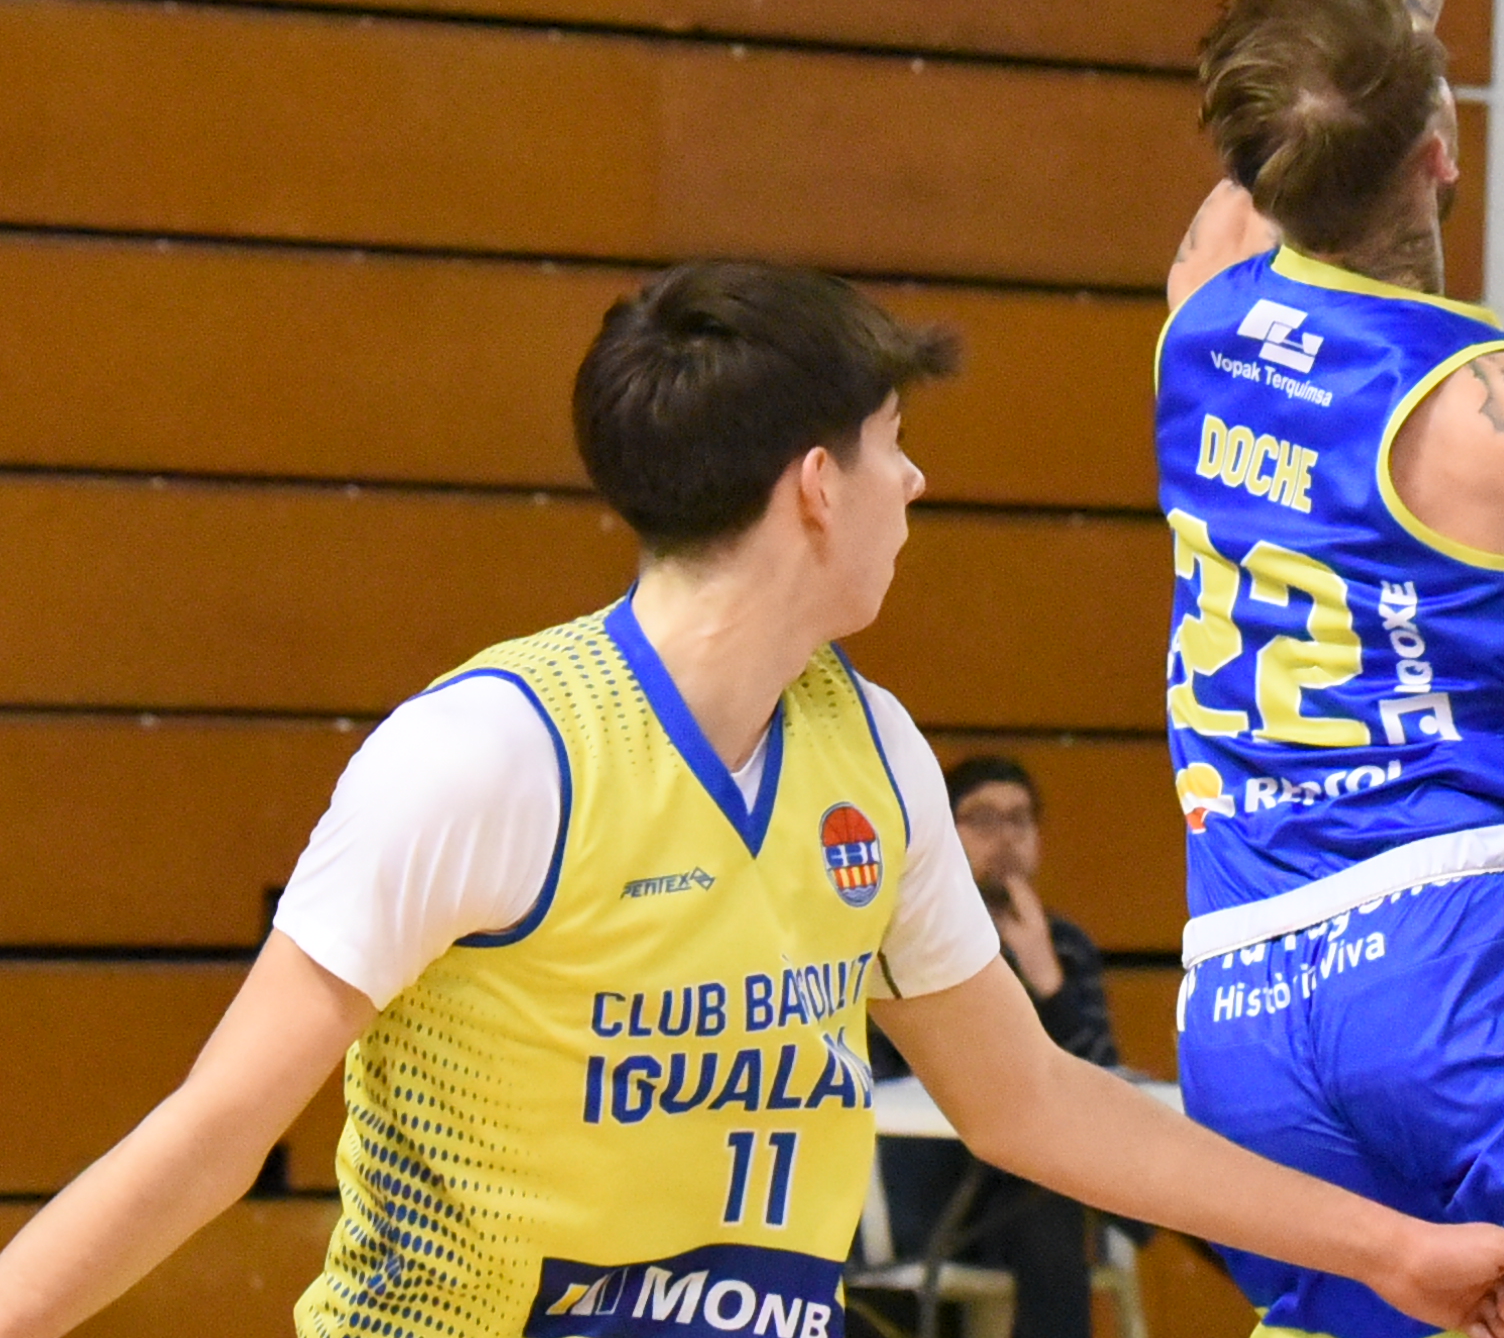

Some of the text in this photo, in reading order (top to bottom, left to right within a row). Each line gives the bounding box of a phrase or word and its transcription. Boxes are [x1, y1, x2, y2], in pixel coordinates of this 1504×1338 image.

[1210, 350, 1262, 383] Vopak
[1195, 412, 1319, 515] DOCHE
[1167, 507, 1371, 747] 22
[1378, 580, 1434, 693] IQOXE
[590, 981, 727, 1038] CLUB
[722, 1130, 798, 1227] 11
